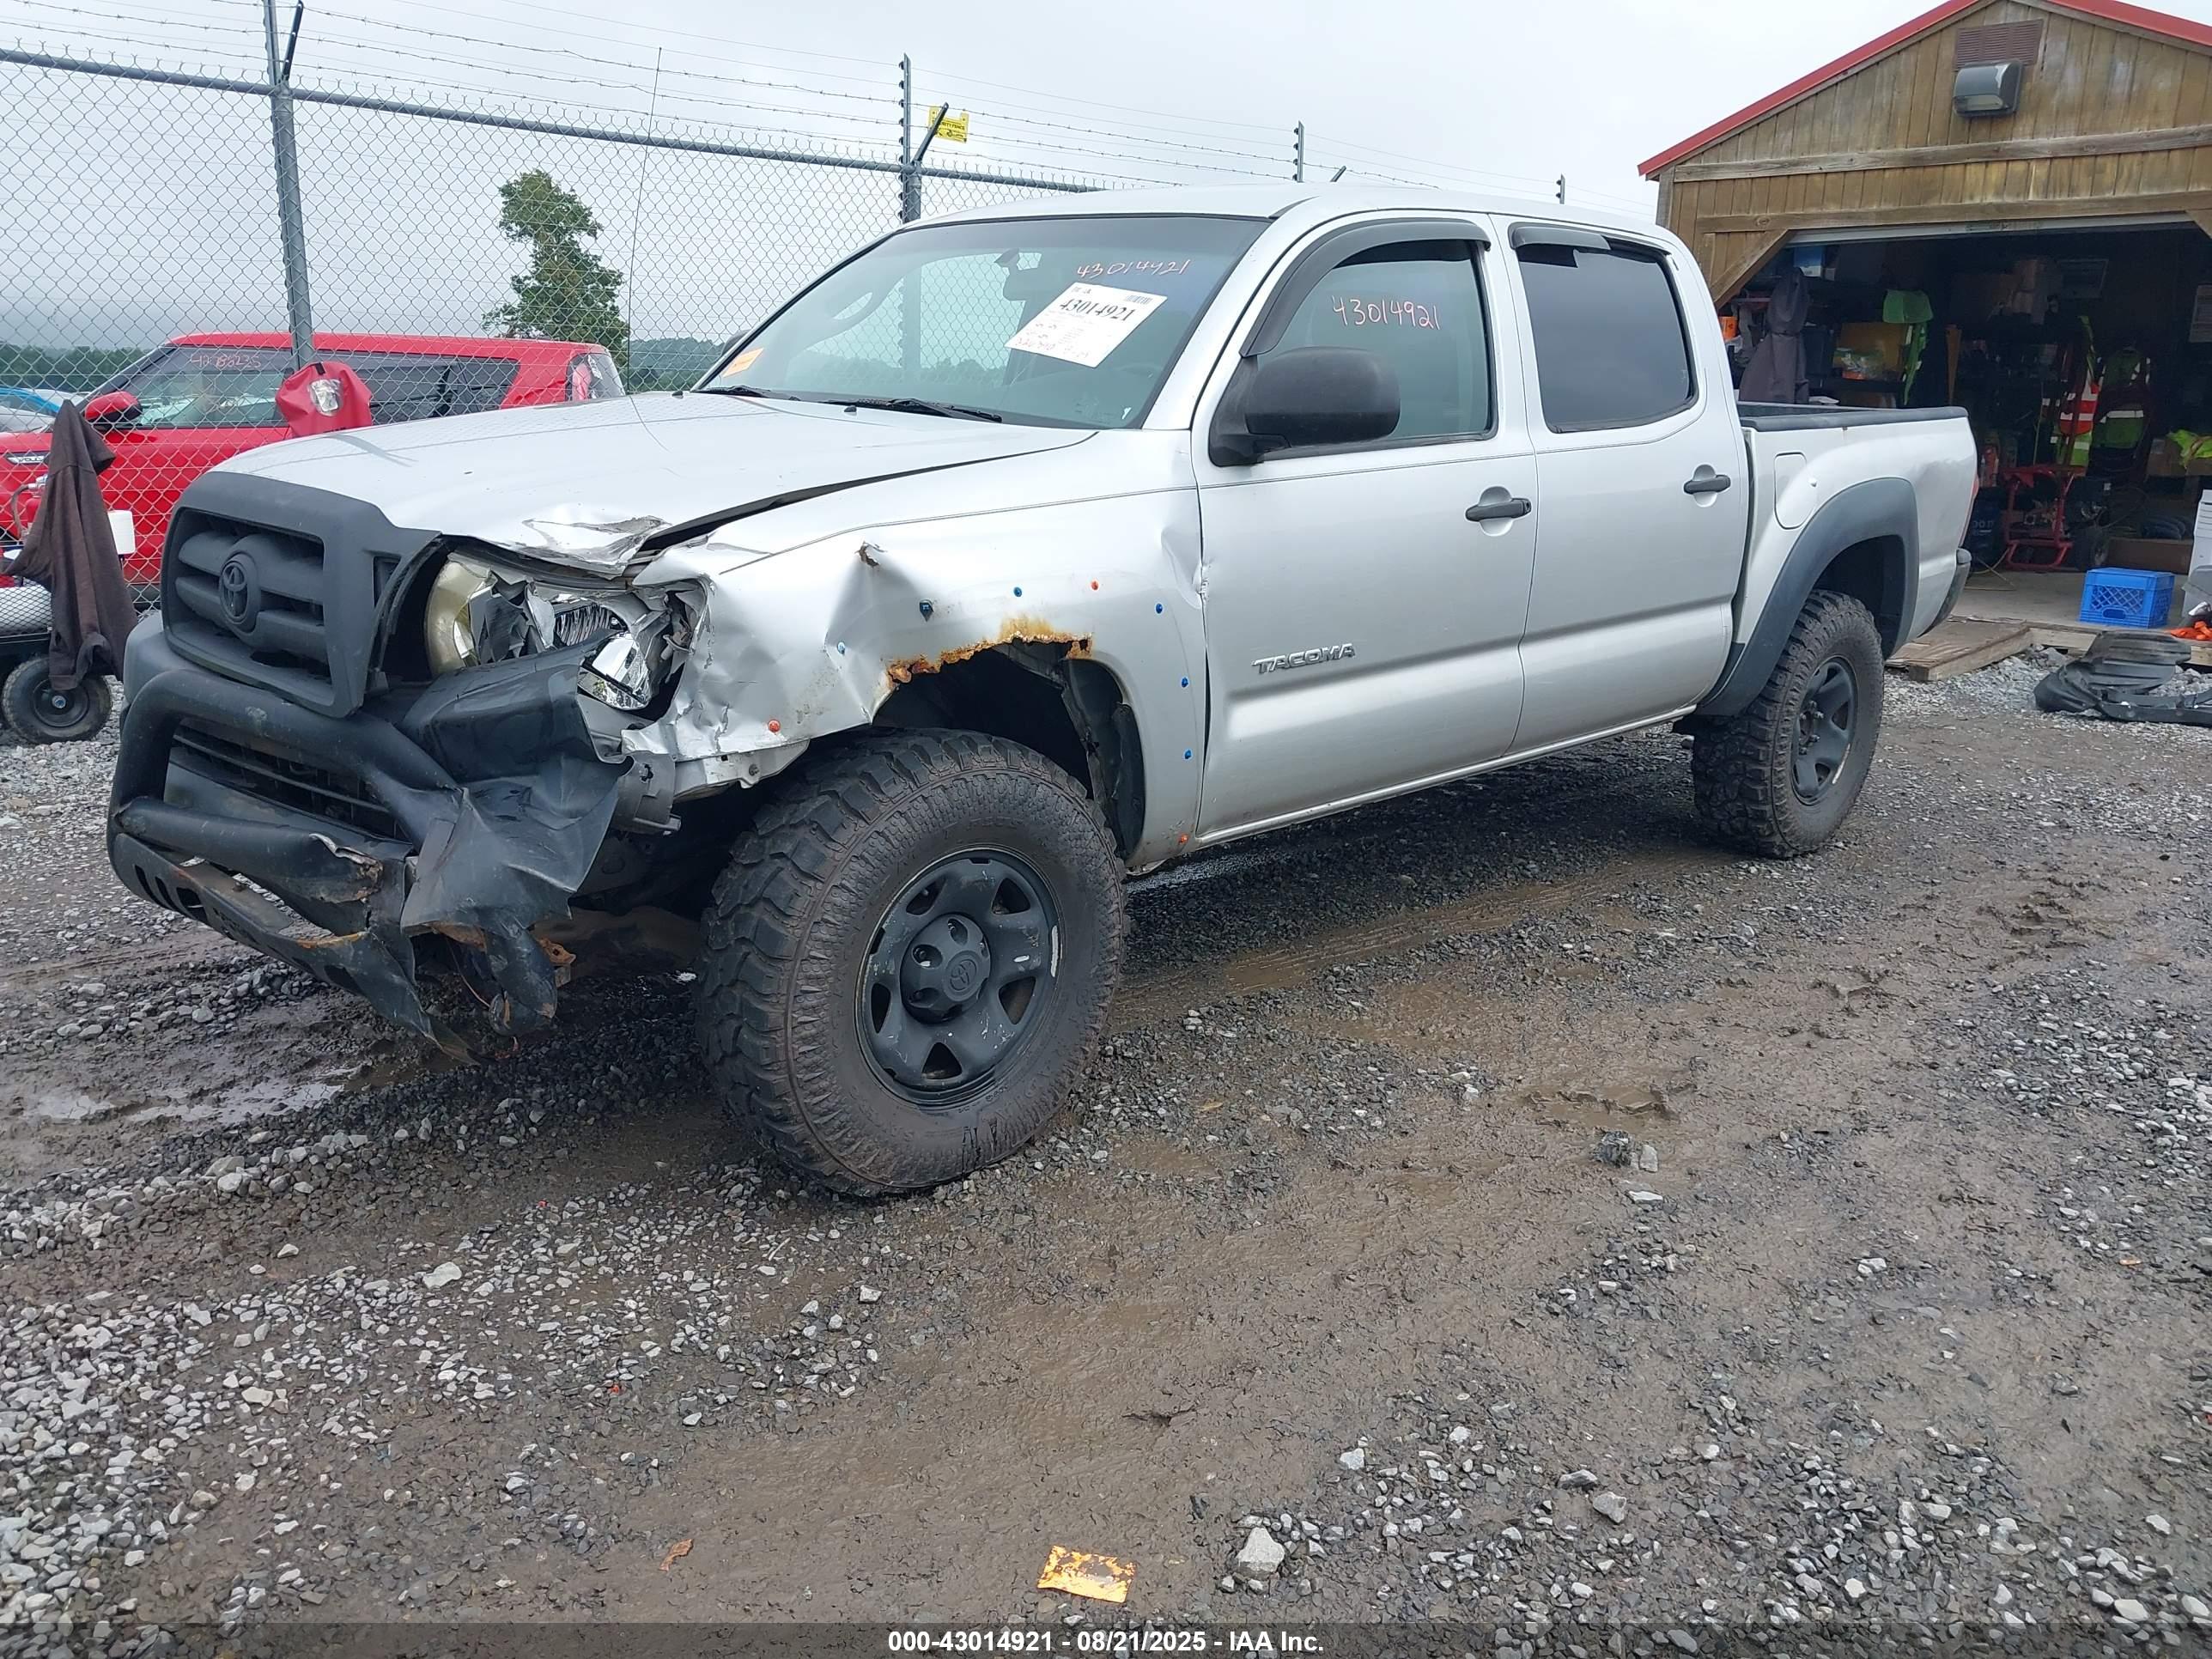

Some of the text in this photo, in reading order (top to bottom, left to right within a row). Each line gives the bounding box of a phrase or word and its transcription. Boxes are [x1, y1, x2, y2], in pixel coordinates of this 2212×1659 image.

[1060, 298, 1135, 321] 43014921
[1332, 295, 1440, 330] 43014921
[1251, 643, 1356, 675] TACOMA
